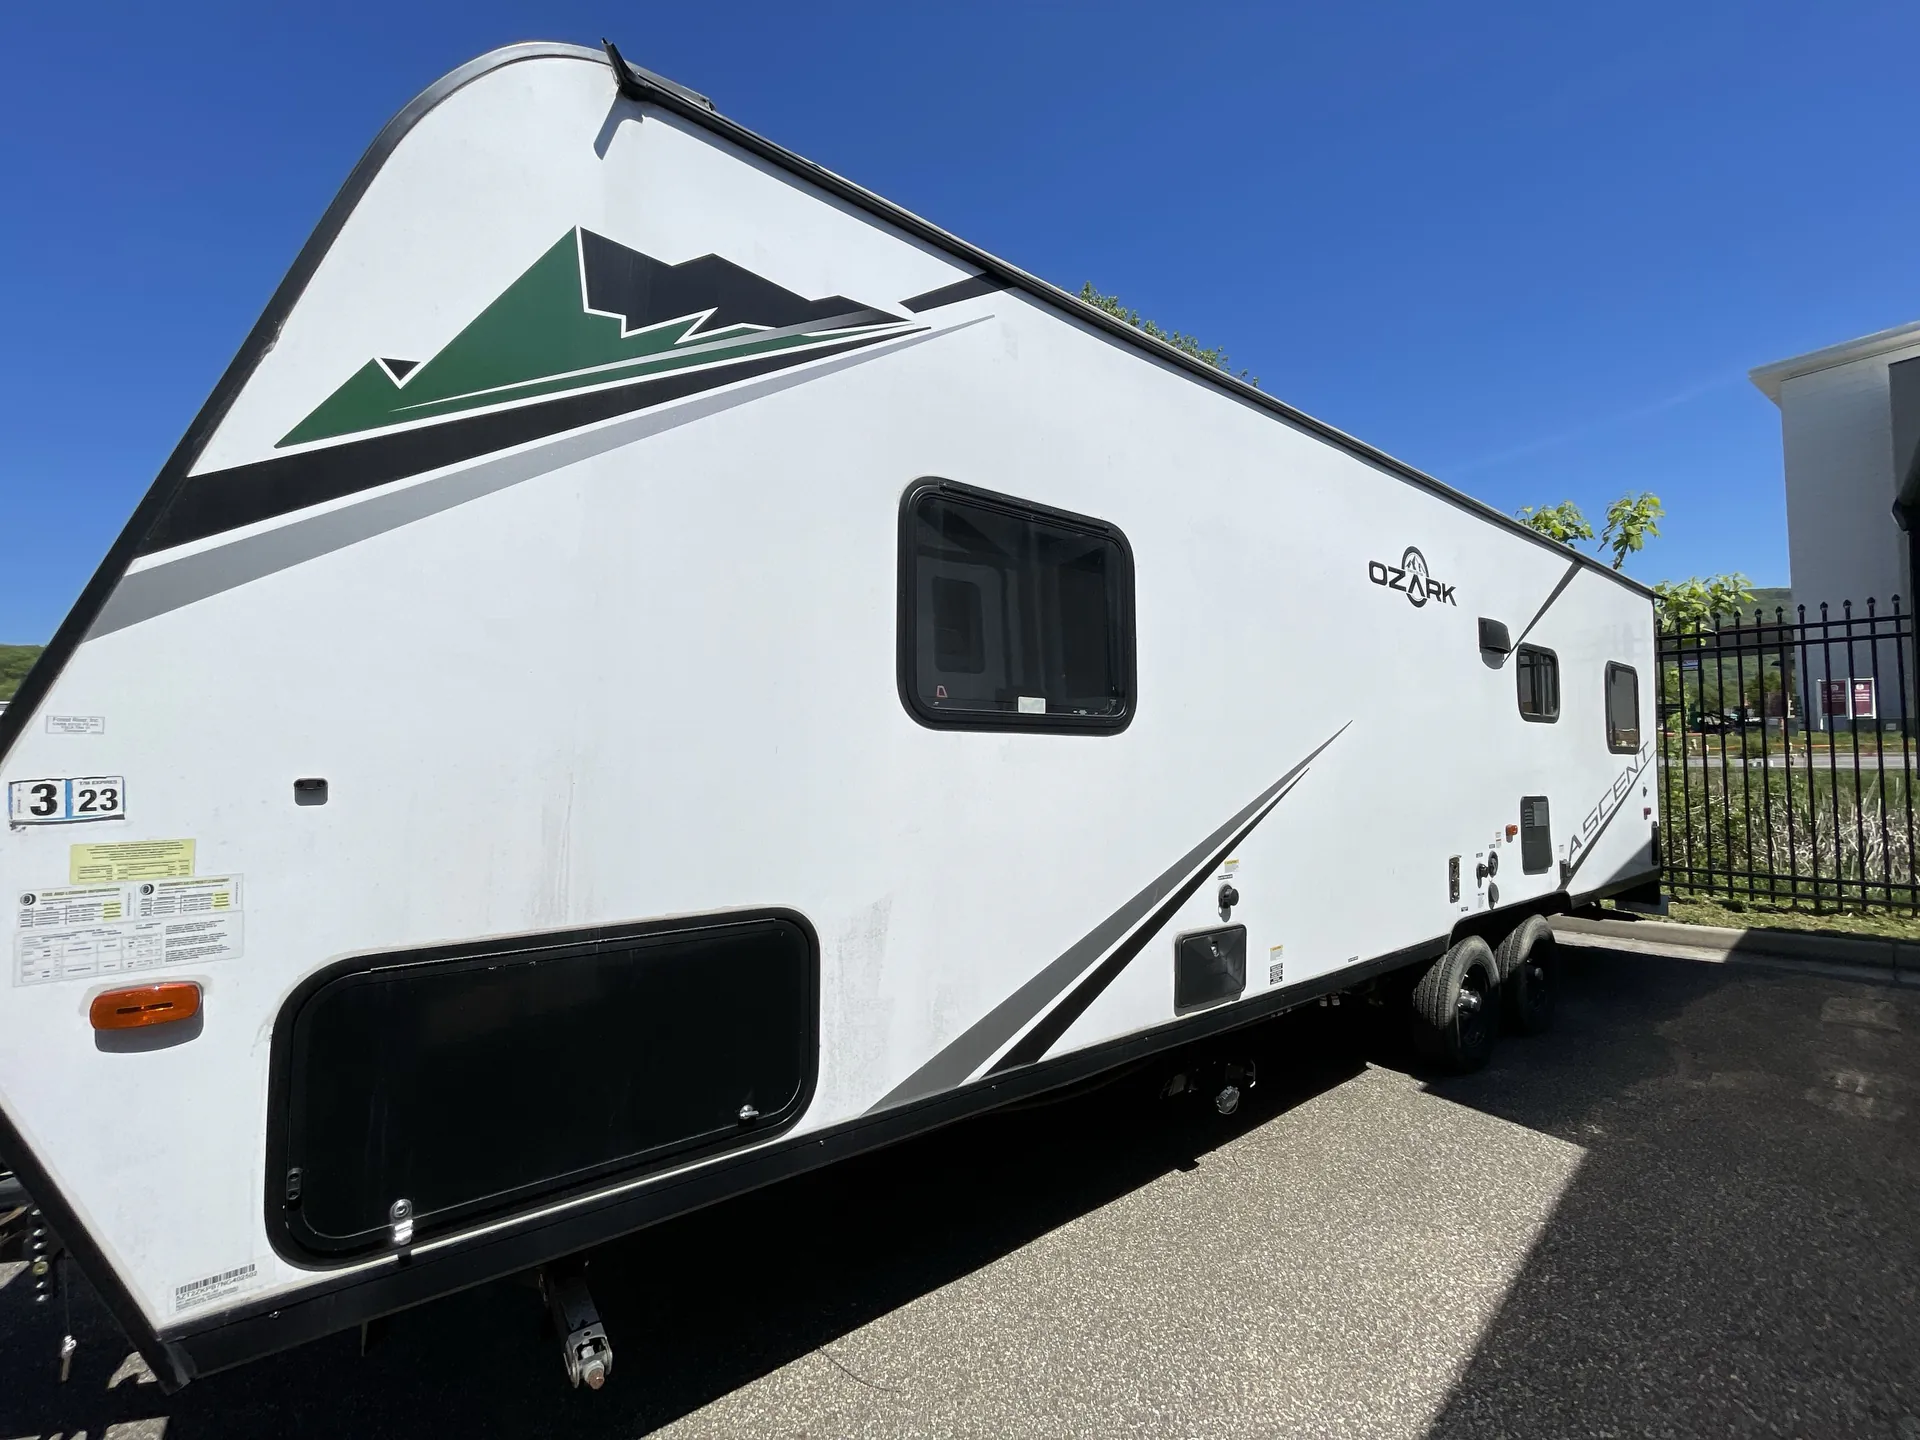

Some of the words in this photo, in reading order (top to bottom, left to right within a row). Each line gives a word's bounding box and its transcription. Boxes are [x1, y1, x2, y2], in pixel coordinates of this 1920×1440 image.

[1369, 560, 1457, 607] OZARK
[30, 784, 58, 816] 3
[79, 788, 118, 812] 23
[1569, 741, 1649, 868] ASCENT
